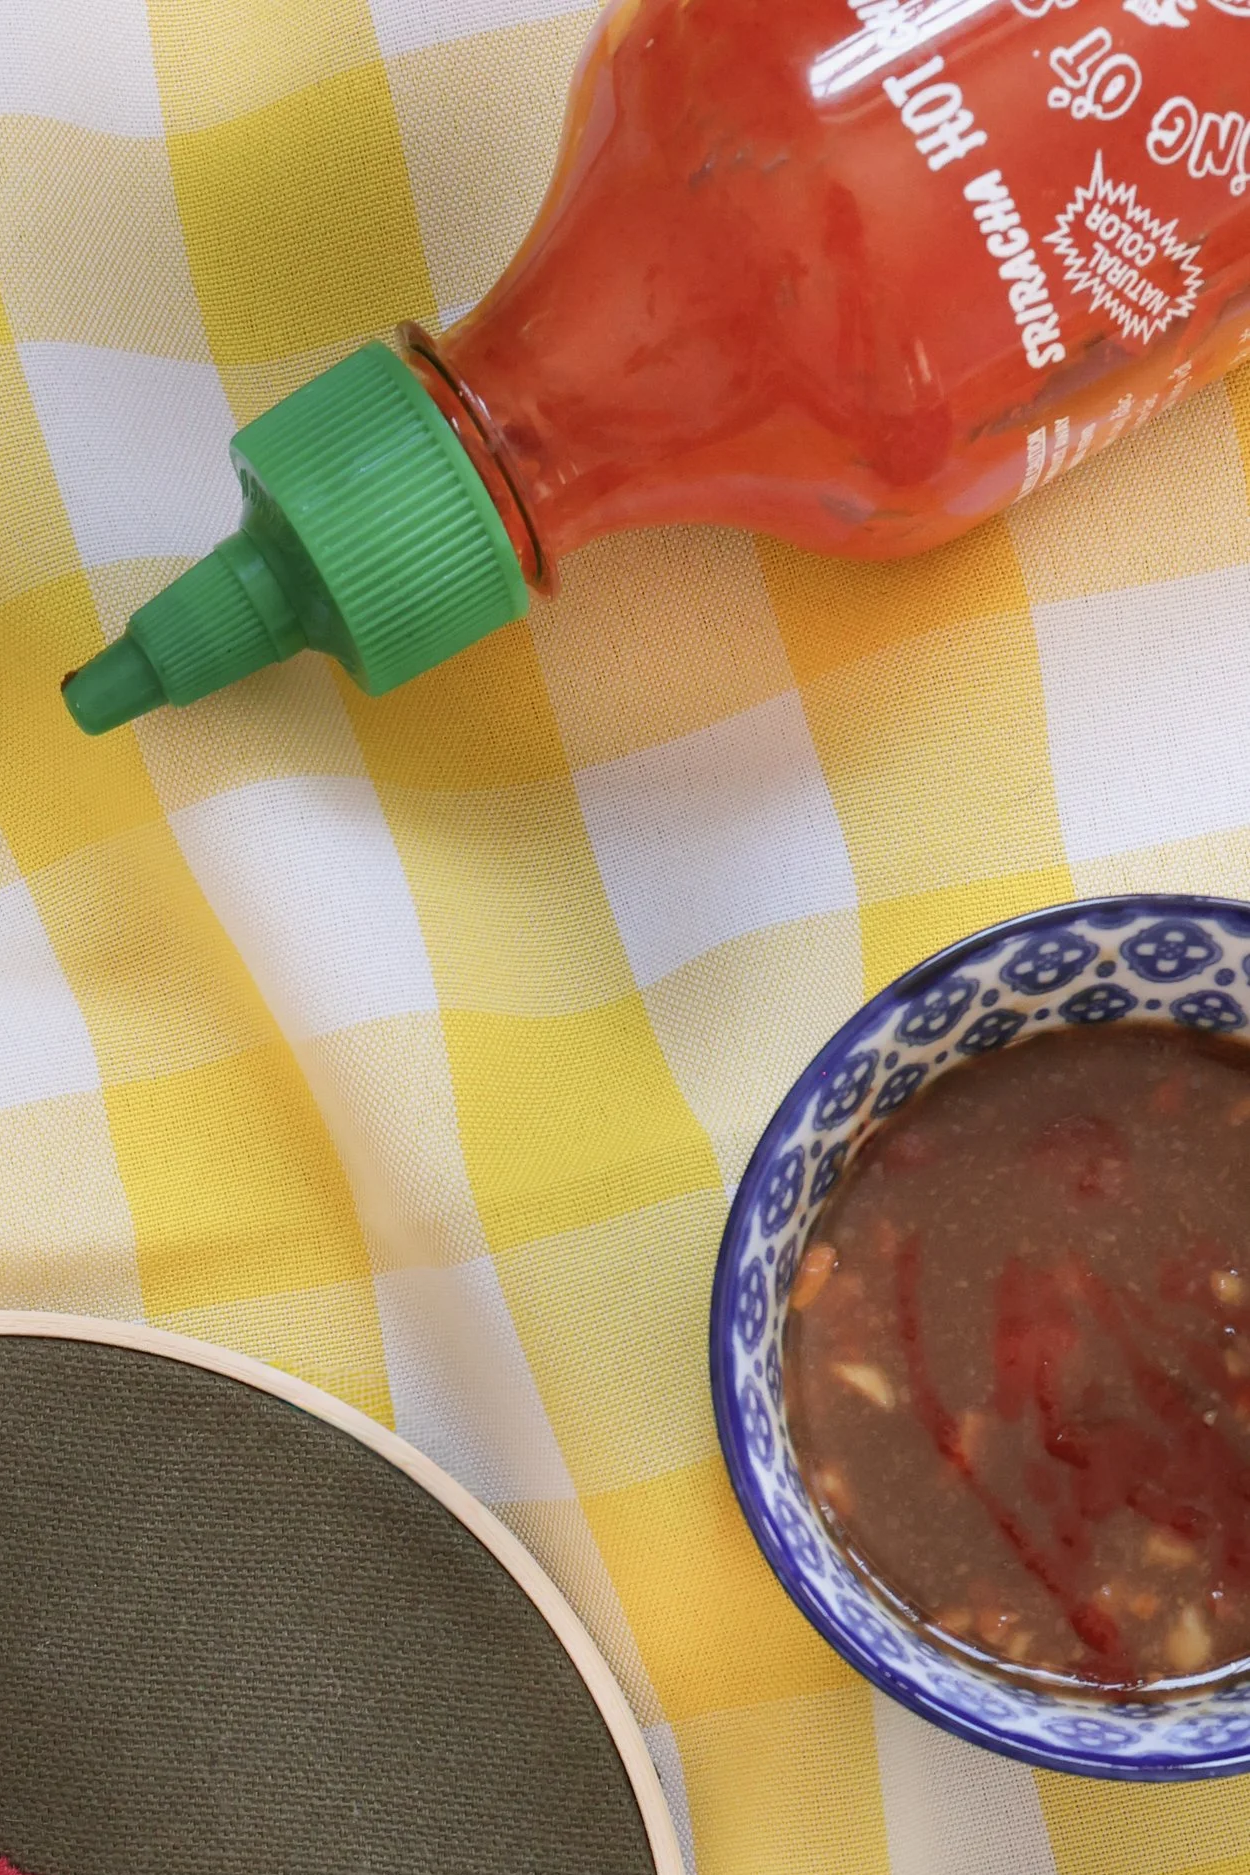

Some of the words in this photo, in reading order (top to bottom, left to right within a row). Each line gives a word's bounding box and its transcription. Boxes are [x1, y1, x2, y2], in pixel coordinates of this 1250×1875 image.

[882, 54, 988, 171] HOT
[963, 169, 1066, 368] SRIRACHA
[1084, 202, 1157, 267] COLOR
[1088, 241, 1170, 315] NATURAL
